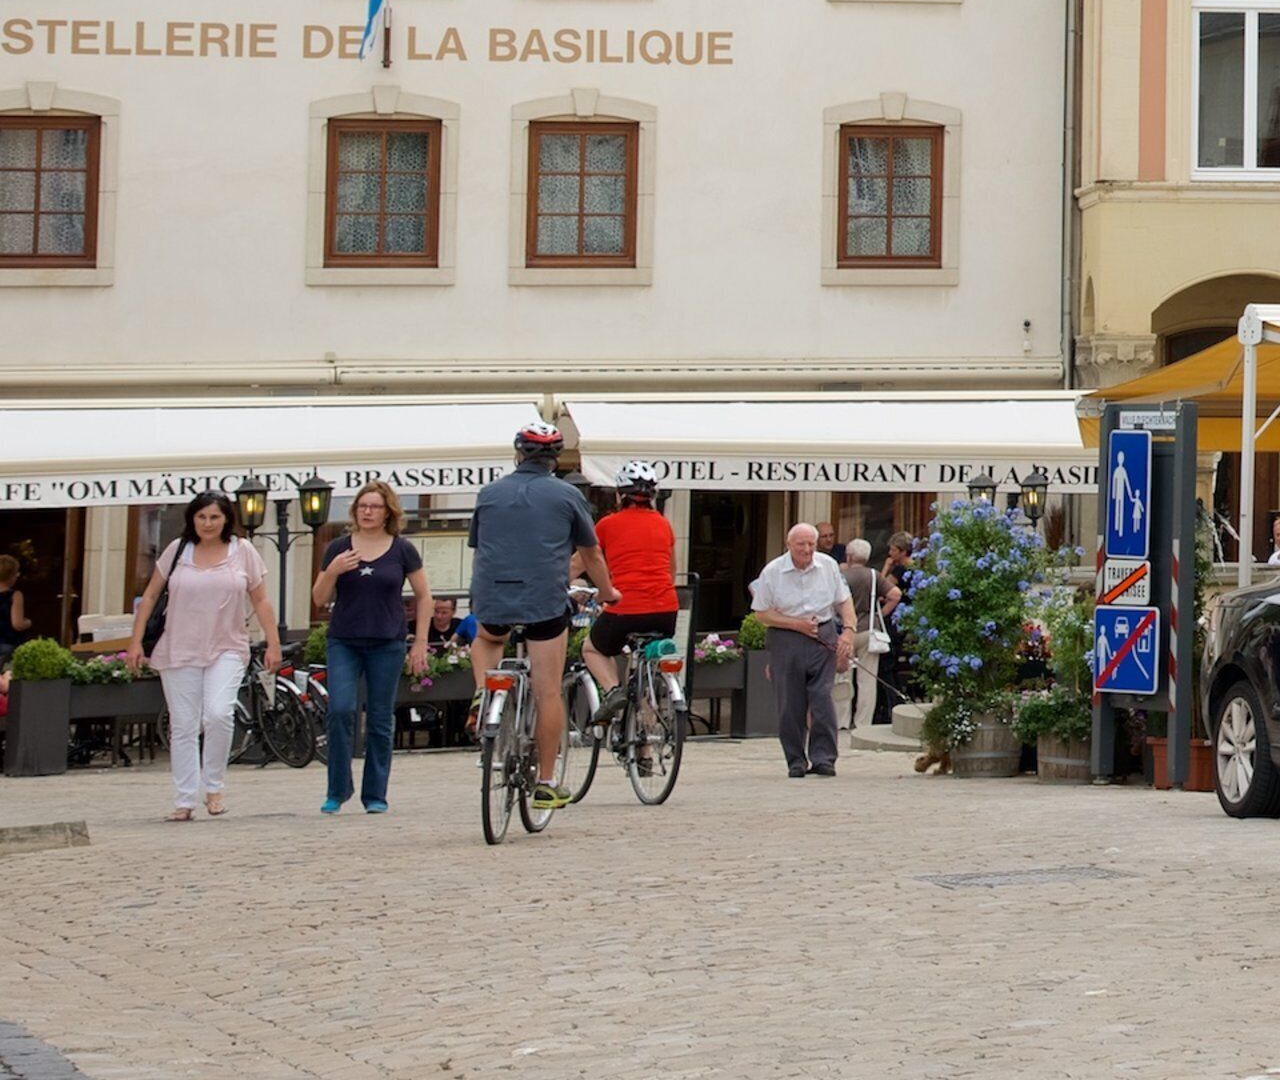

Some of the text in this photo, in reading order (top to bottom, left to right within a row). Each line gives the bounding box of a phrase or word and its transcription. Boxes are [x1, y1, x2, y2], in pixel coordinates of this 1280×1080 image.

[1, 18, 734, 65] STELLERIE DE LA BASILIQUE
[630, 461, 723, 481] OTEL
[747, 461, 927, 482] RESTAURANT
[939, 464, 973, 484] DE
[987, 465, 1021, 484] LA
[0, 482, 41, 501] FE
